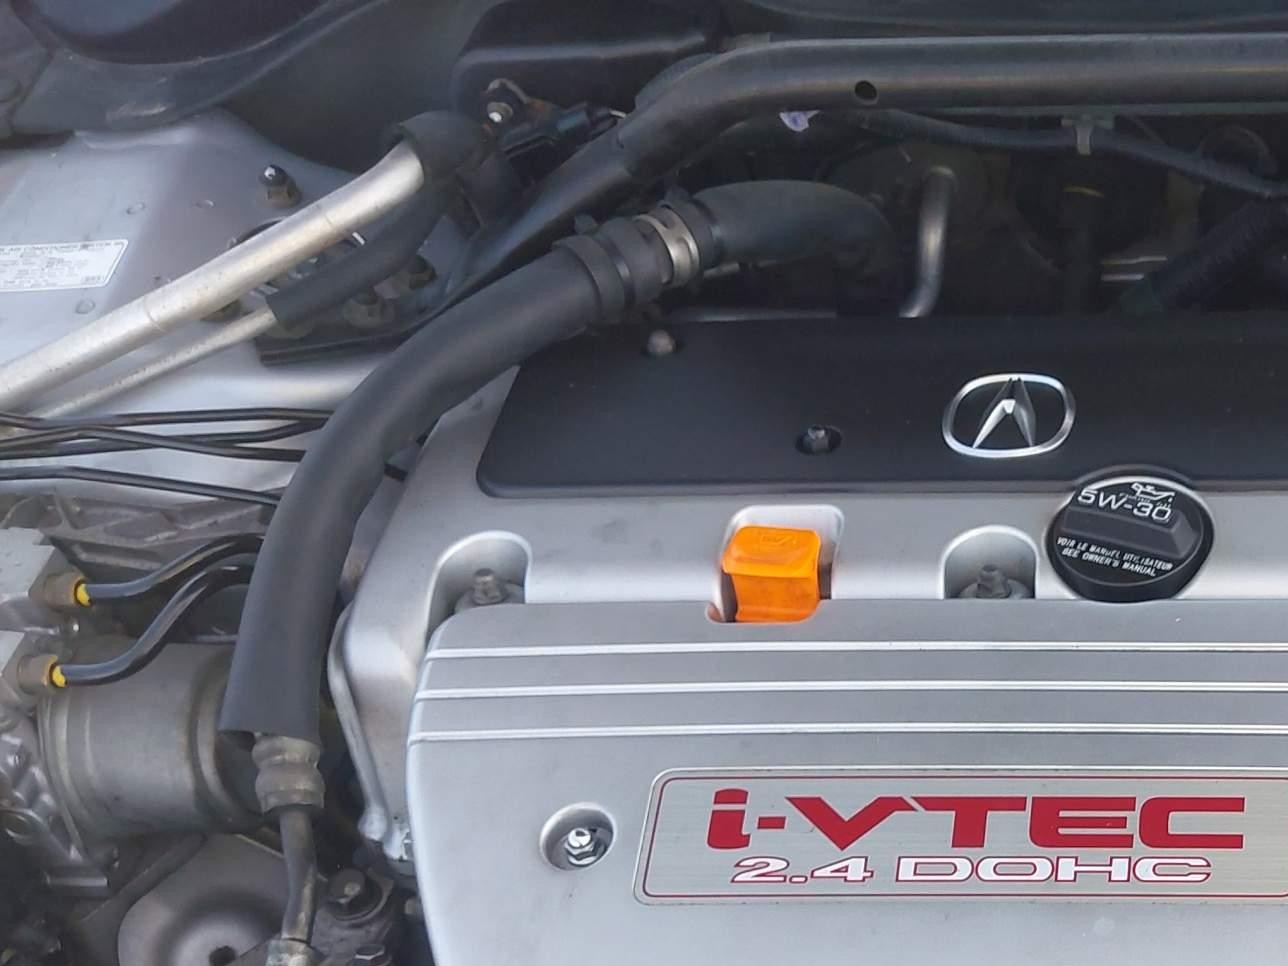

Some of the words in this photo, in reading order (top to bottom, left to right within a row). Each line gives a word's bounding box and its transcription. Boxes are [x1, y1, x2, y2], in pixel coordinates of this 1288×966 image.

[1077, 488, 1172, 522] 5W-30
[1057, 537, 1075, 548] VOIR
[1077, 542, 1088, 551] LE
[1089, 544, 1121, 560] MANUEL
[1062, 548, 1079, 559] SEE
[1082, 552, 1119, 568] OWNER'S
[1122, 562, 1157, 577] MANUAL
[707, 788, 1246, 851] i-VTEC
[730, 855, 874, 884] 2.4
[895, 855, 1212, 883] DOHC
